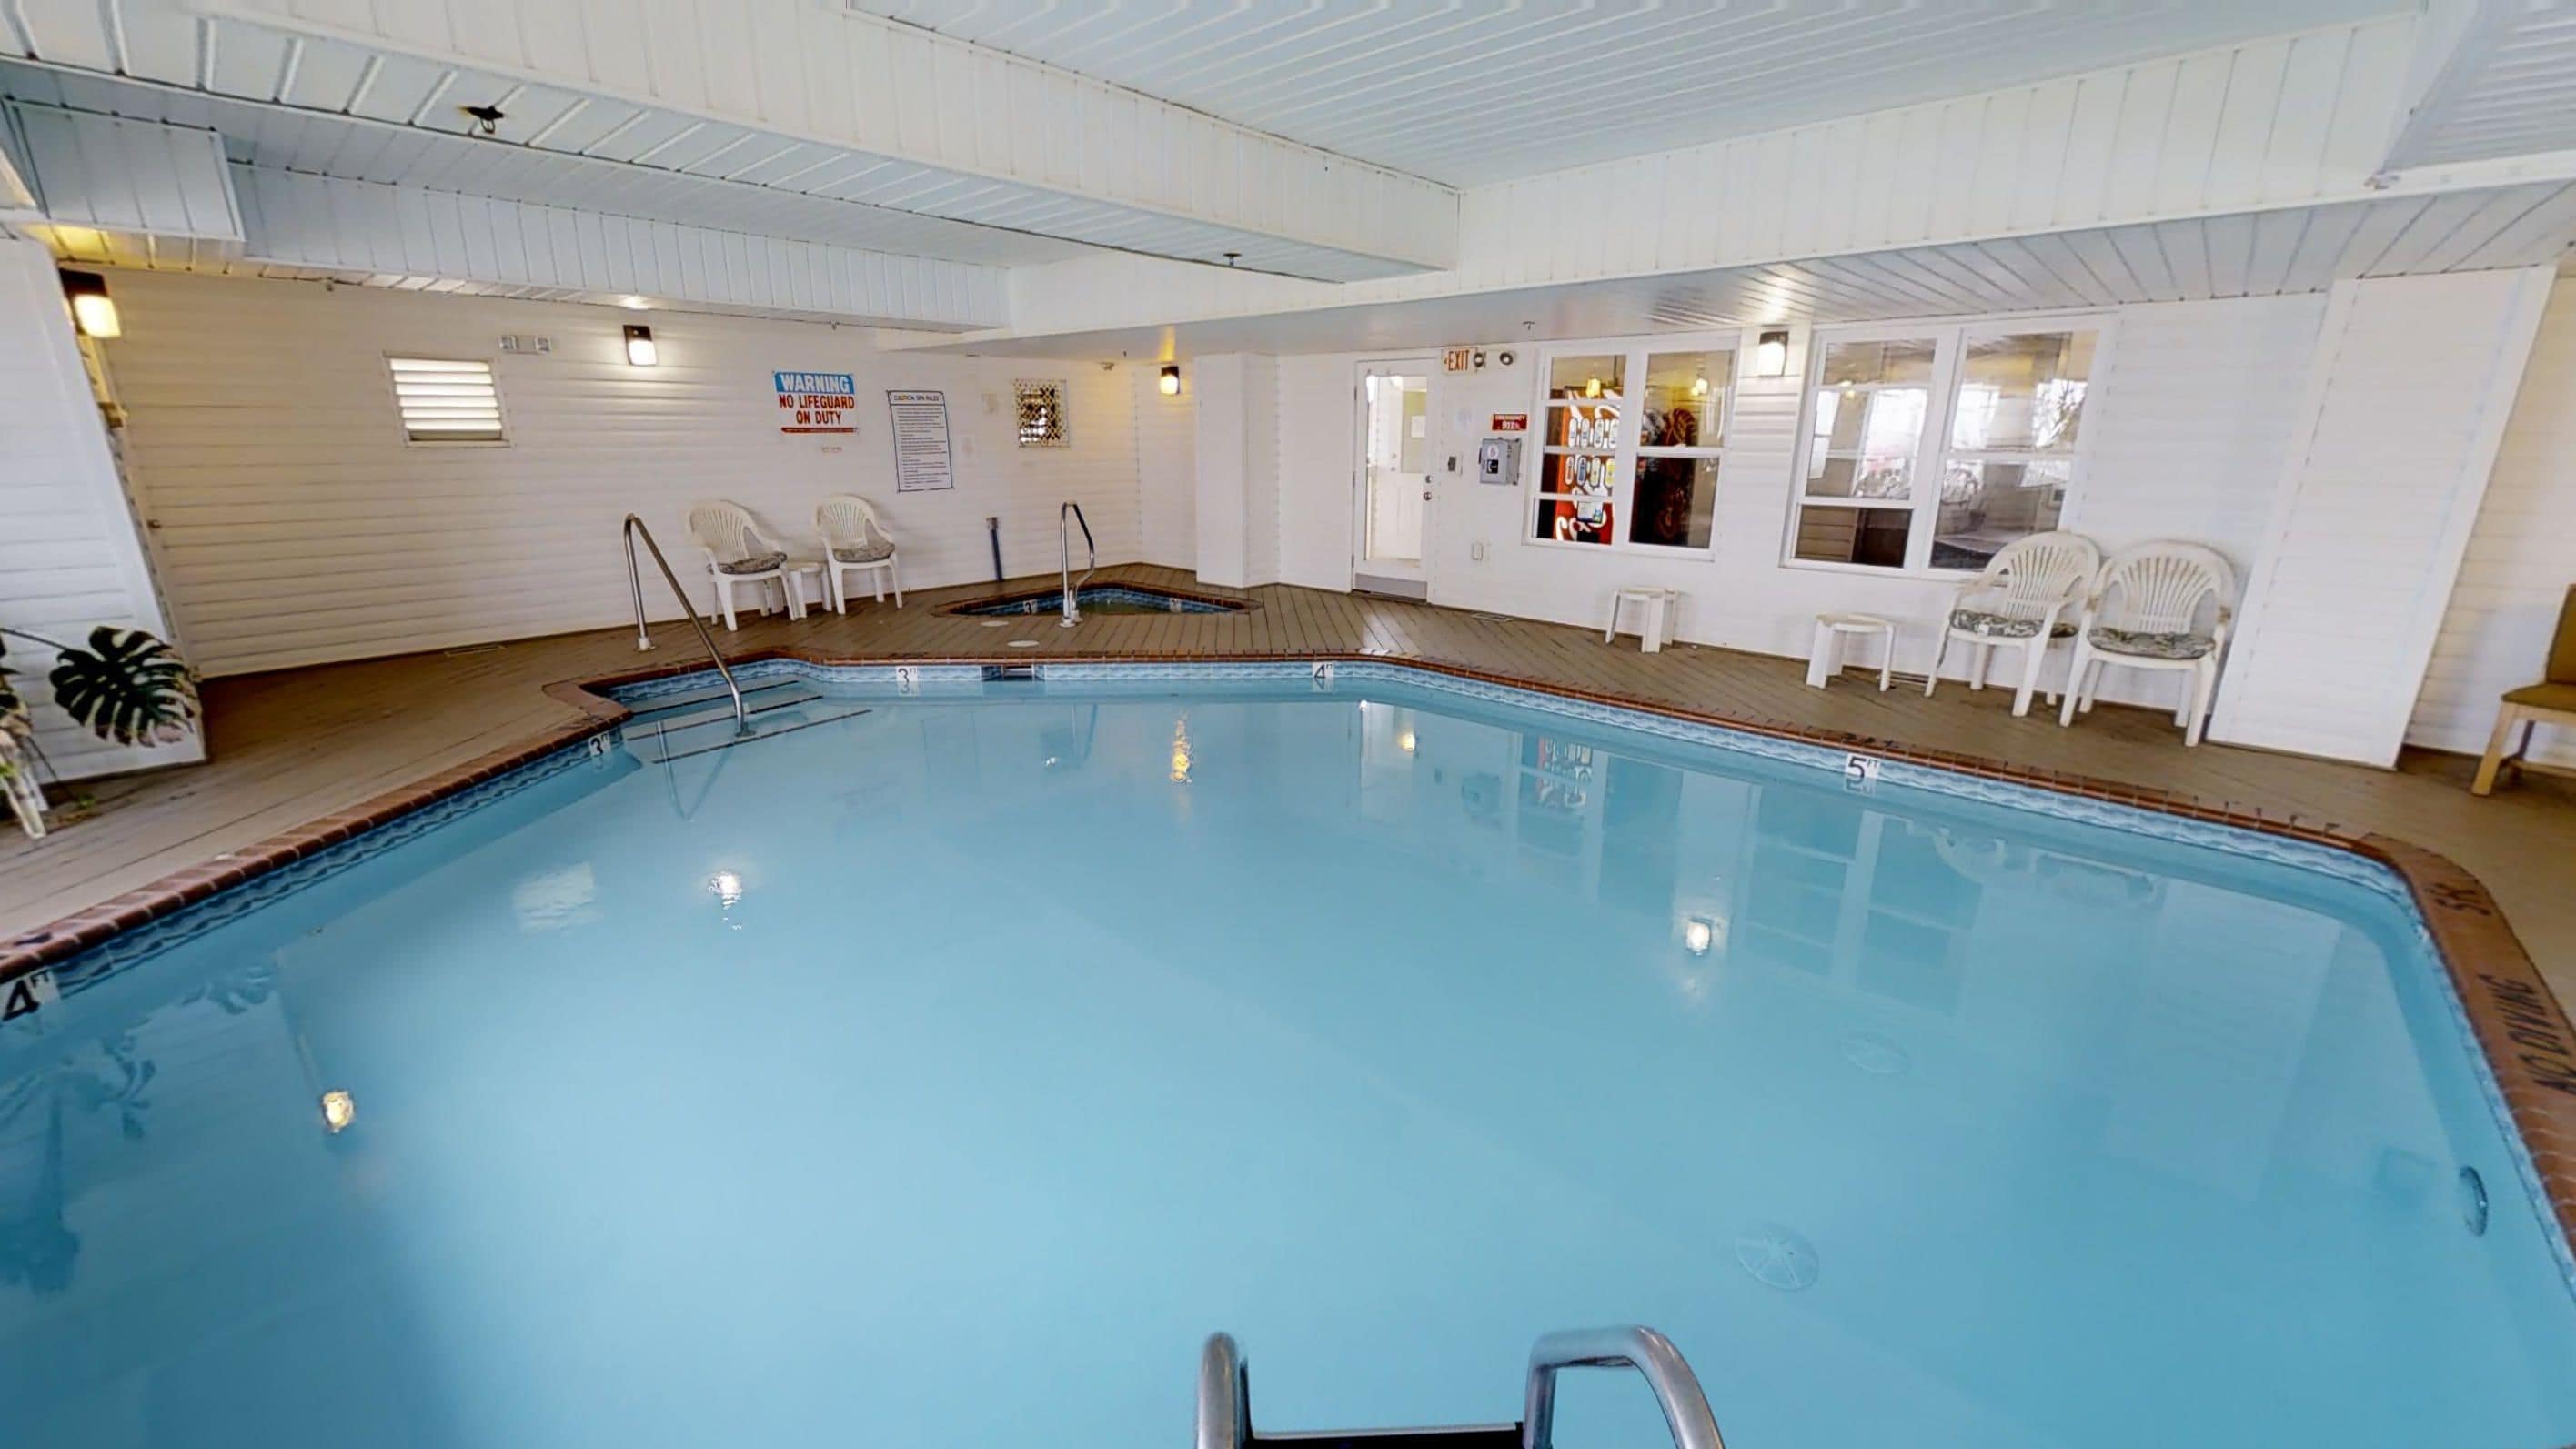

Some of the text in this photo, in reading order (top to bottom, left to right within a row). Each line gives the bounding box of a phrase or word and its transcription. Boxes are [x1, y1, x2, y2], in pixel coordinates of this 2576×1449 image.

[1447, 349, 1470, 372] EXIT
[779, 373, 850, 393] WARNING
[779, 394, 855, 409] NO LIFEGUARD
[796, 410, 841, 425] ON DUTY
